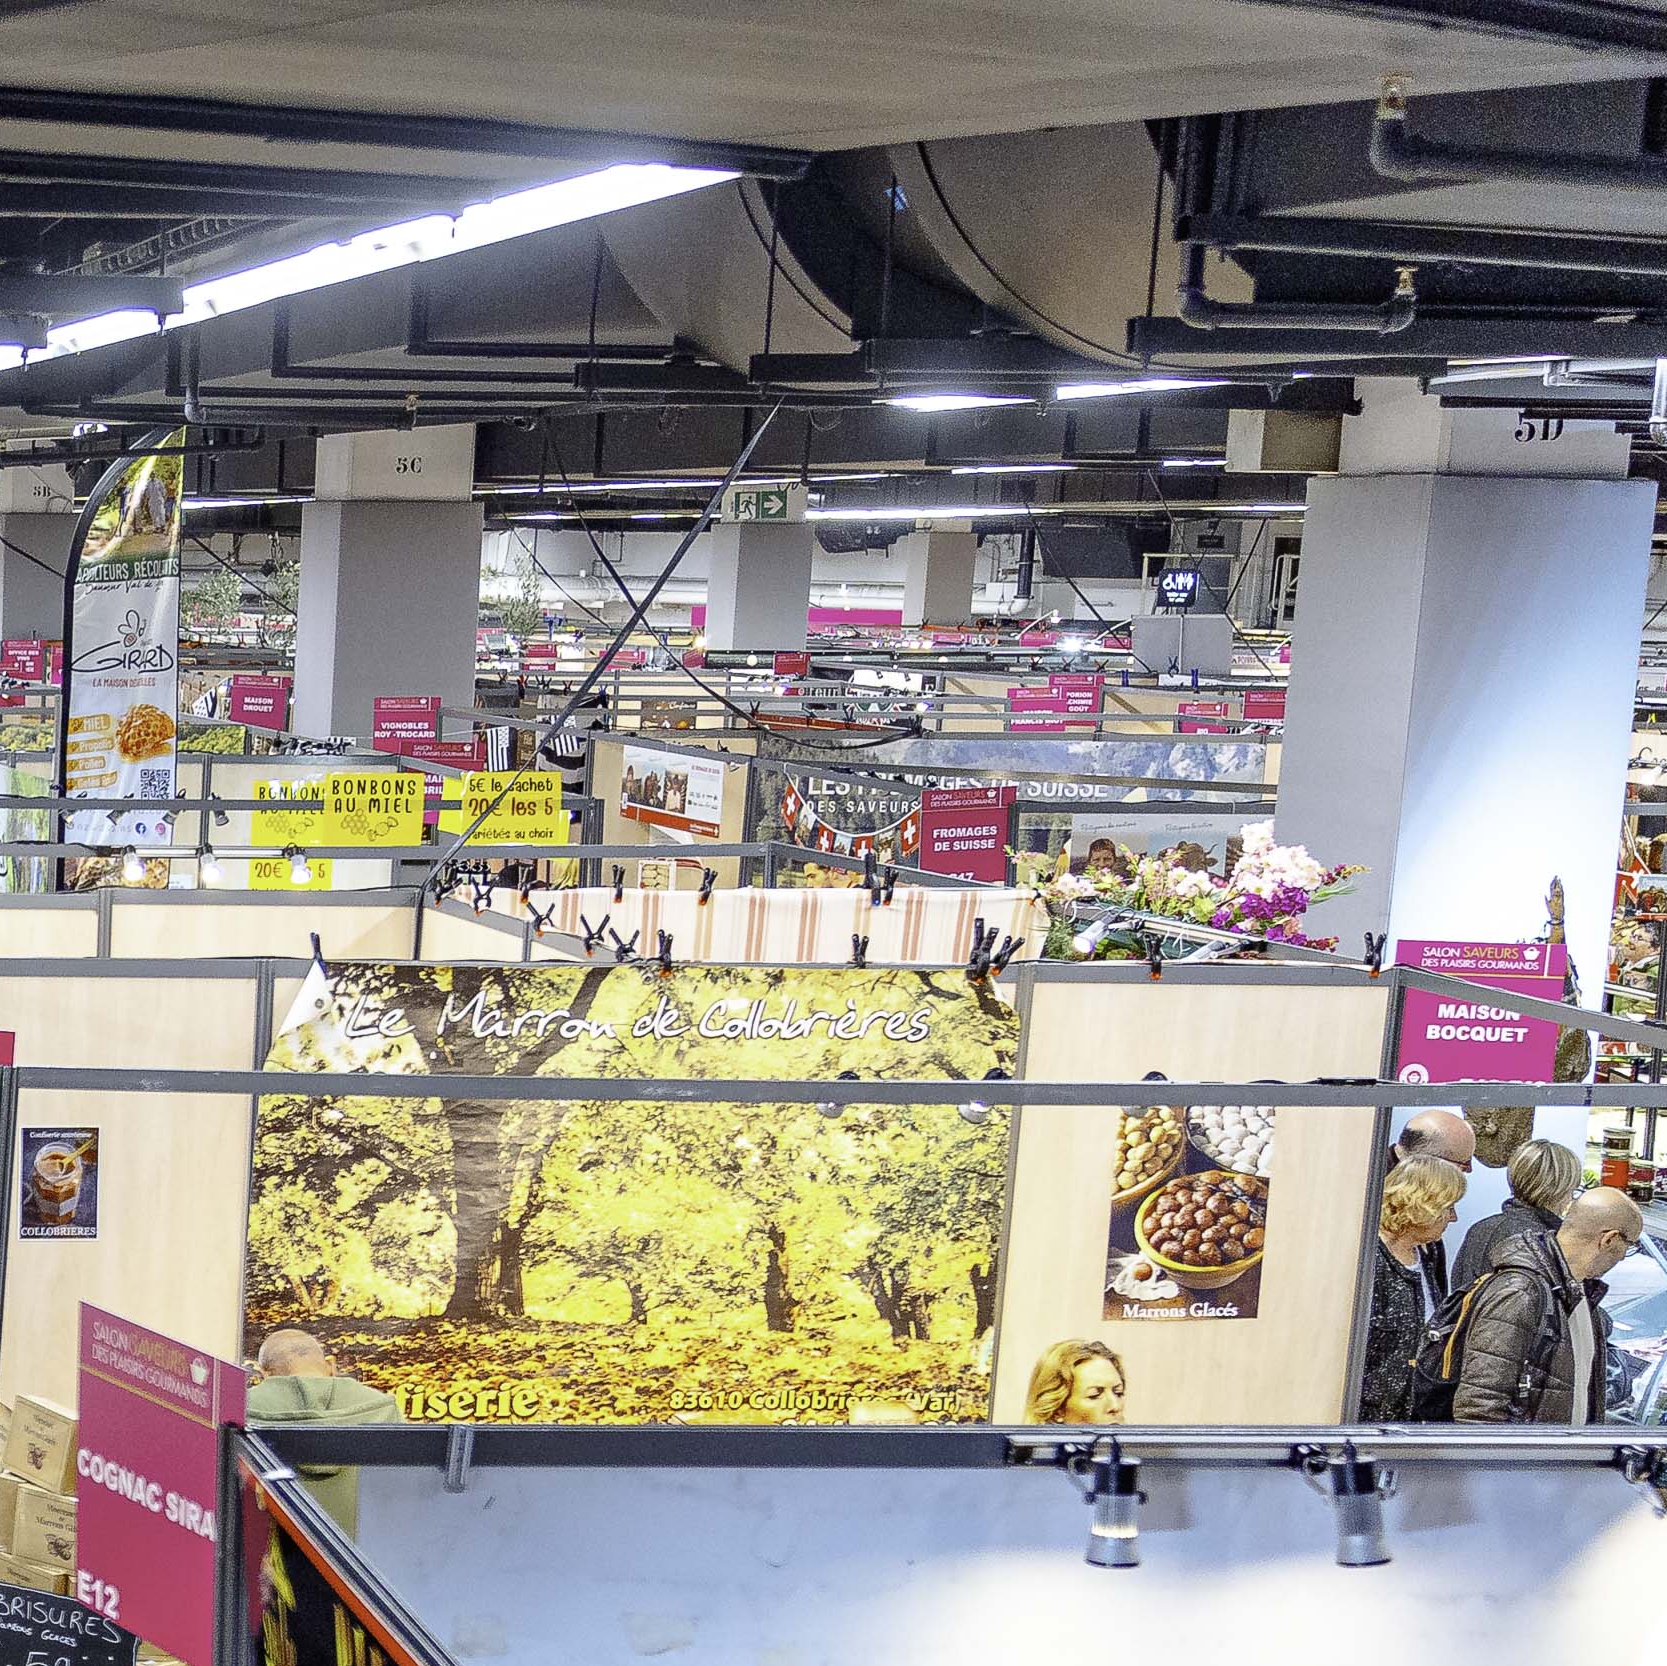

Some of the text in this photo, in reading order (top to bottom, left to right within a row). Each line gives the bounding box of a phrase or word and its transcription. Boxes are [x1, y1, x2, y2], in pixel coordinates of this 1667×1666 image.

[1514, 411, 1565, 443] 5D
[395, 455, 423, 475] 5C
[243, 697, 273, 705] MAISON
[381, 721, 429, 731] VIGNOBLES
[374, 731, 391, 739] ROY
[331, 779, 416, 795] BONBONS
[469, 777, 503, 793] 5€ le
[809, 778, 850, 796] LES
[1024, 781, 1108, 798] SUISSE
[930, 790, 986, 801] SALON SAVEURS
[334, 797, 413, 814] AU MIEL
[468, 799, 554, 817] 20€ les 5
[807, 800, 918, 813] DES SAVEURS
[515, 828, 555, 839] au choix
[933, 826, 997, 839] FROMAGES
[934, 839, 996, 851] DE SUISSE
[254, 862, 282, 878] 20€
[317, 862, 326, 878] 5
[1422, 946, 1519, 960] SALON SAVEURS
[1421, 958, 1540, 971] DES PLAISIRS GOURMANDS
[345, 996, 931, 1043] Le Marron de Collobrières
[1437, 1003, 1521, 1021] MAISON
[1426, 1024, 1528, 1043] BOCQUET
[1122, 1301, 1238, 1319] Marrons Glacés
[91, 1320, 130, 1354] SALON
[91, 1343, 208, 1408] DES PLAISIRS GOURMANDS
[669, 1391, 743, 1411] 83610
[77, 1449, 162, 1514] COGNAC
[76, 1571, 120, 1620] E12
